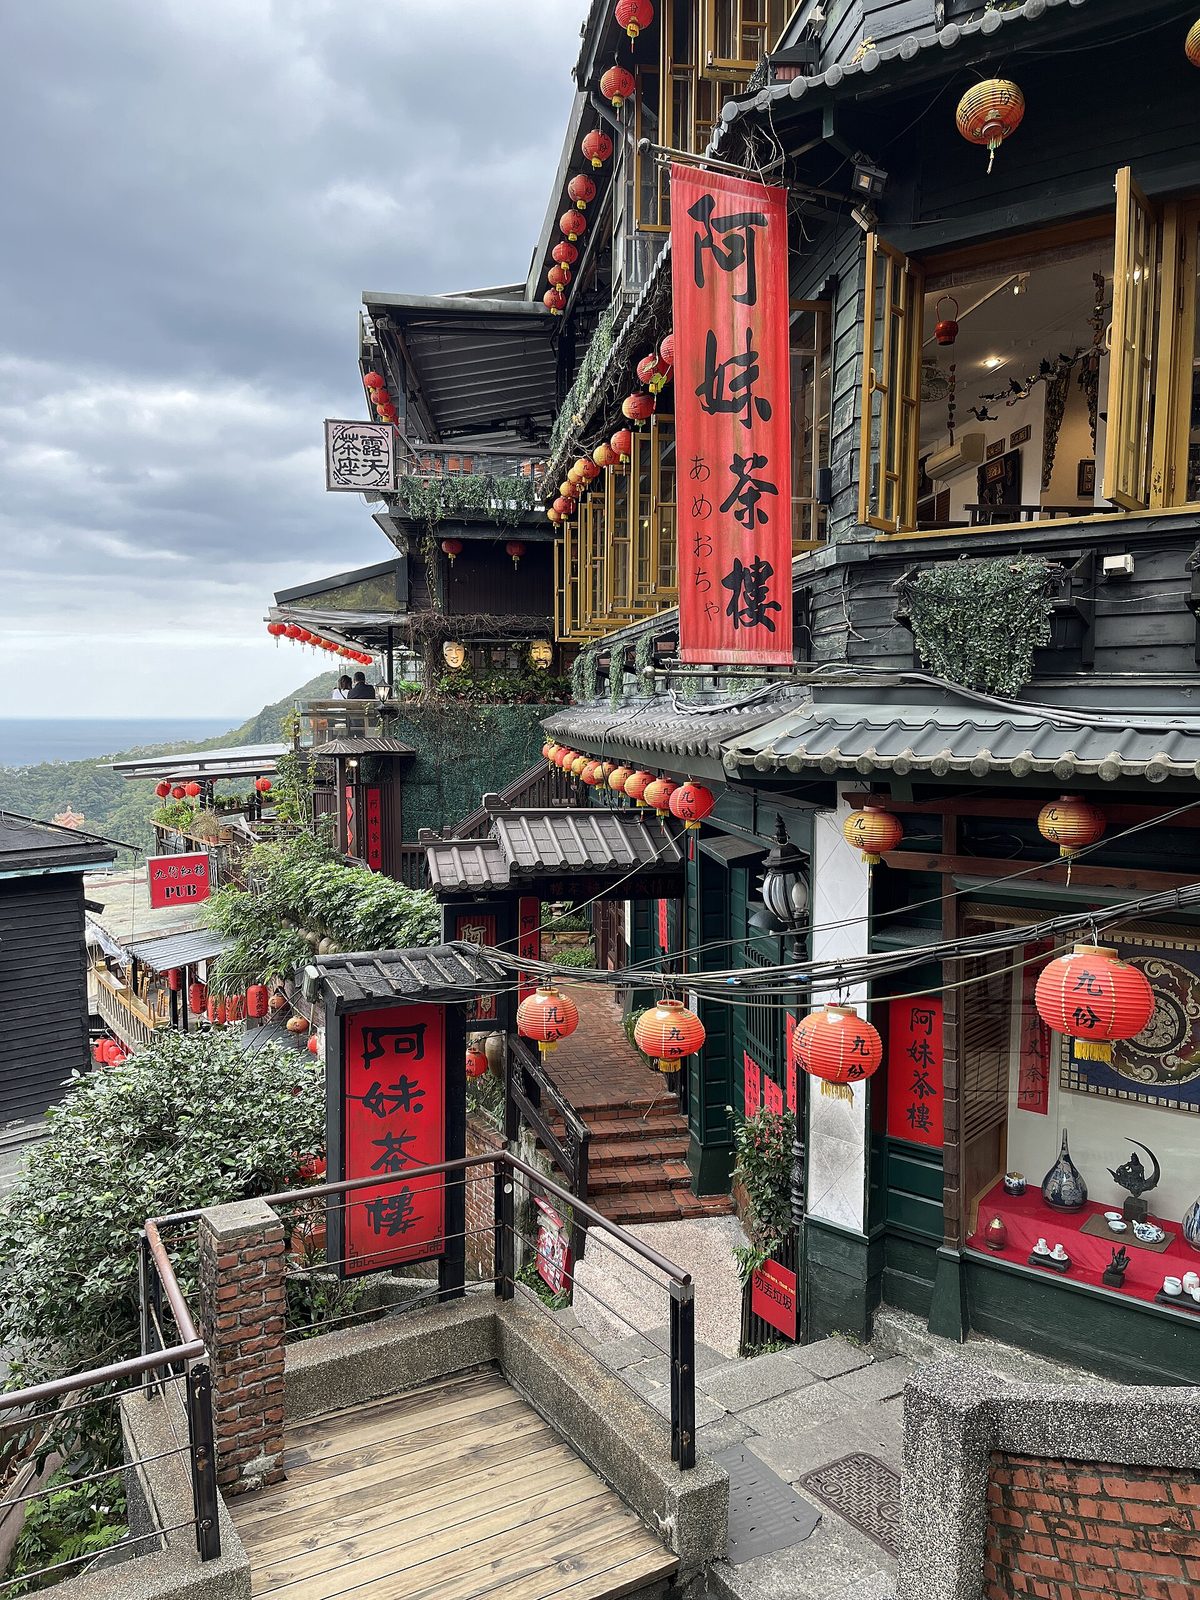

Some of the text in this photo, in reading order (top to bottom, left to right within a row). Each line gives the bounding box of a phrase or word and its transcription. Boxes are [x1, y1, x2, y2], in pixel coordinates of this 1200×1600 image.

[687, 194, 781, 632] 阿妹茶樓
[334, 433, 361, 477] 茶座
[361, 435, 389, 477] 露天
[689, 455, 720, 621] あめおちゃ
[681, 791, 696, 818] 九份
[165, 884, 197, 899] PUB
[1072, 970, 1104, 1030] 九份
[545, 1006, 565, 1041] 九份
[668, 1026, 686, 1056] 九份
[848, 1035, 870, 1078] 九份
[906, 1007, 937, 1133] 阿妹茶樓
[346, 1023, 430, 1237] 阿妹茶樓
